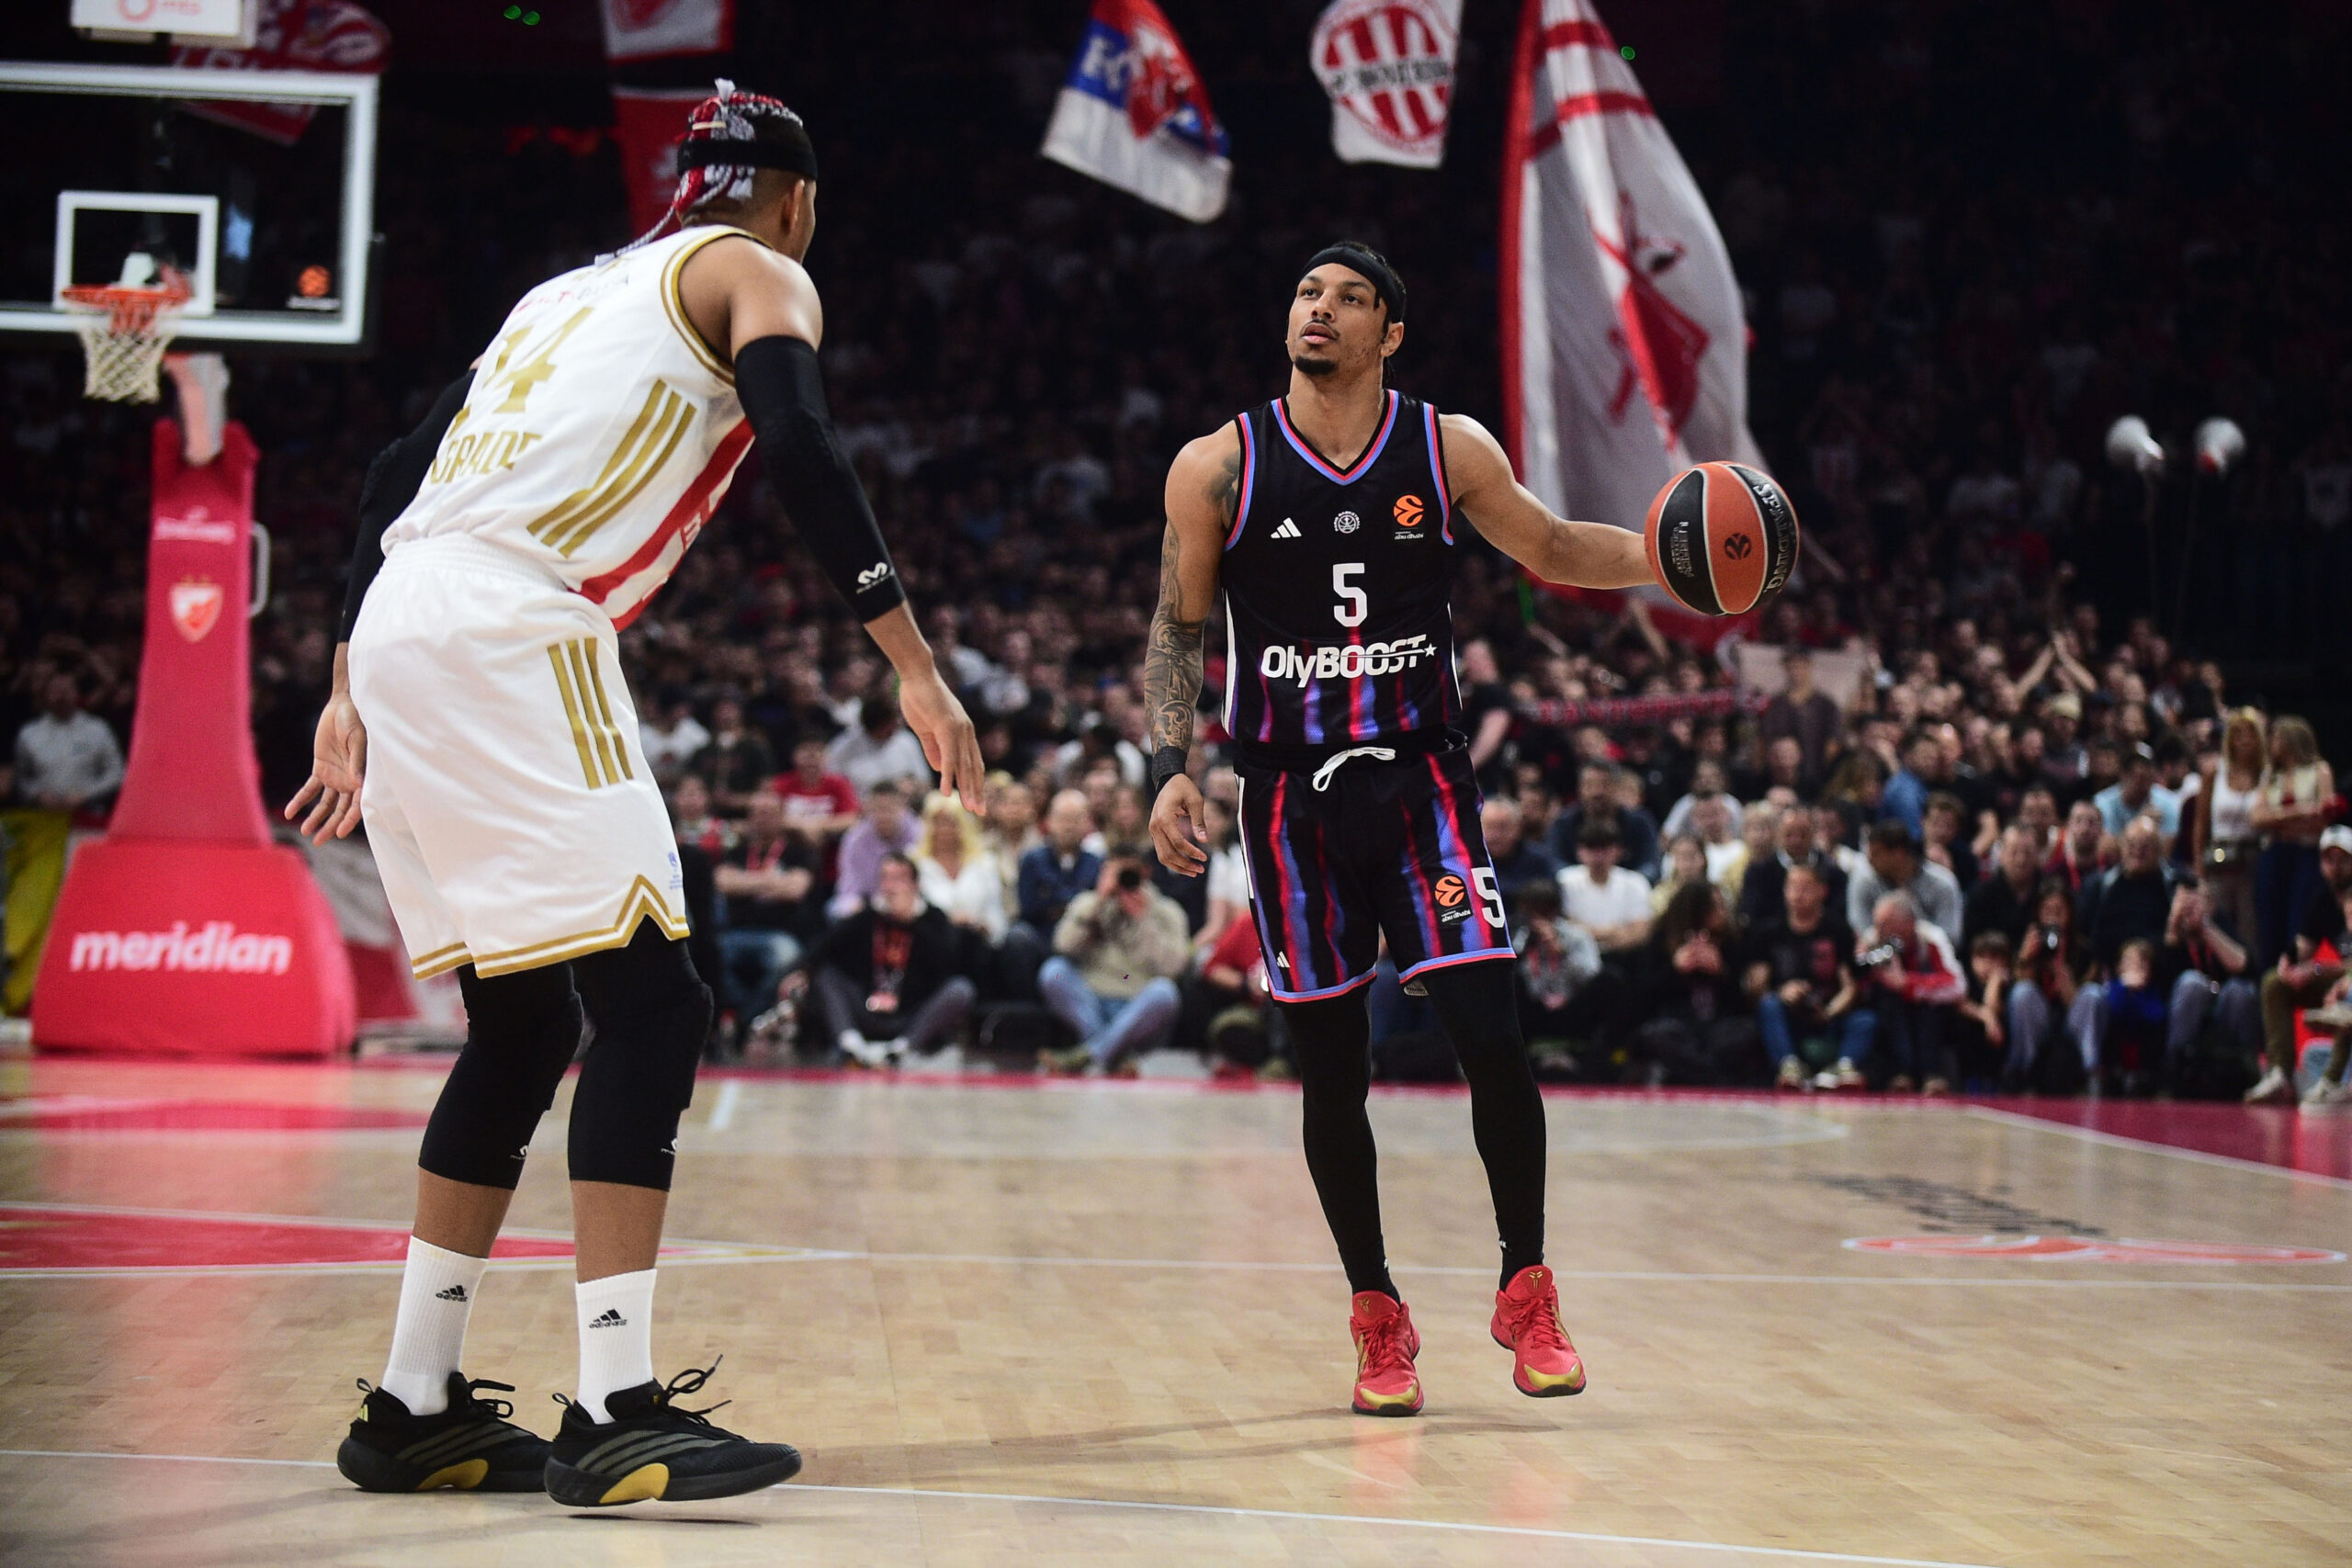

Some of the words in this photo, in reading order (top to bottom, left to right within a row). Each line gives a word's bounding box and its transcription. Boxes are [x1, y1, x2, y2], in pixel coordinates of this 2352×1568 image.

[448, 306, 594, 438] 14
[1333, 562, 1368, 627] 5
[1261, 634, 1427, 688] OlyBOOST
[1470, 867, 1506, 929] 5
[70, 920, 292, 976] meridian
